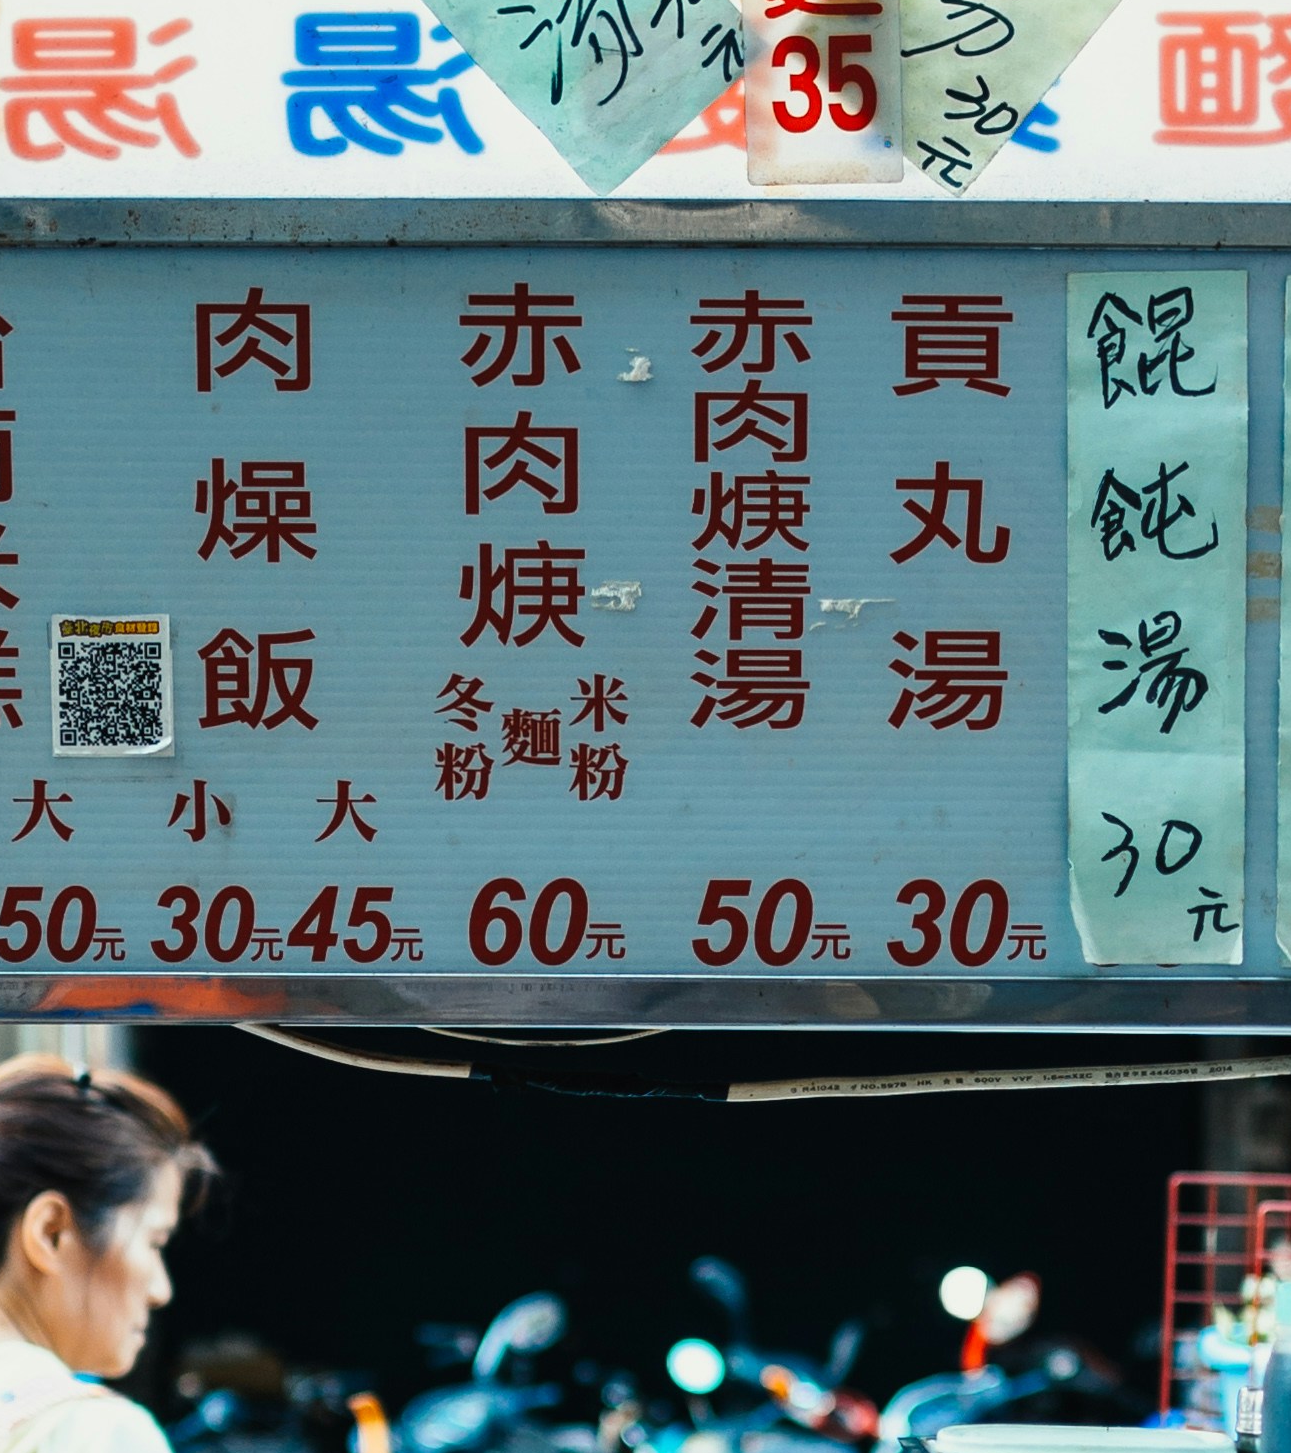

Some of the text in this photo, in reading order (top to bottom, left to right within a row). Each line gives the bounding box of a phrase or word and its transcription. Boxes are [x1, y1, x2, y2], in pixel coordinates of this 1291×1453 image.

[194, 286, 318, 730] 肉燥飯
[887, 294, 1014, 732] 貢丸湯
[12, 778, 75, 841] 大
[168, 779, 378, 842] 小 大
